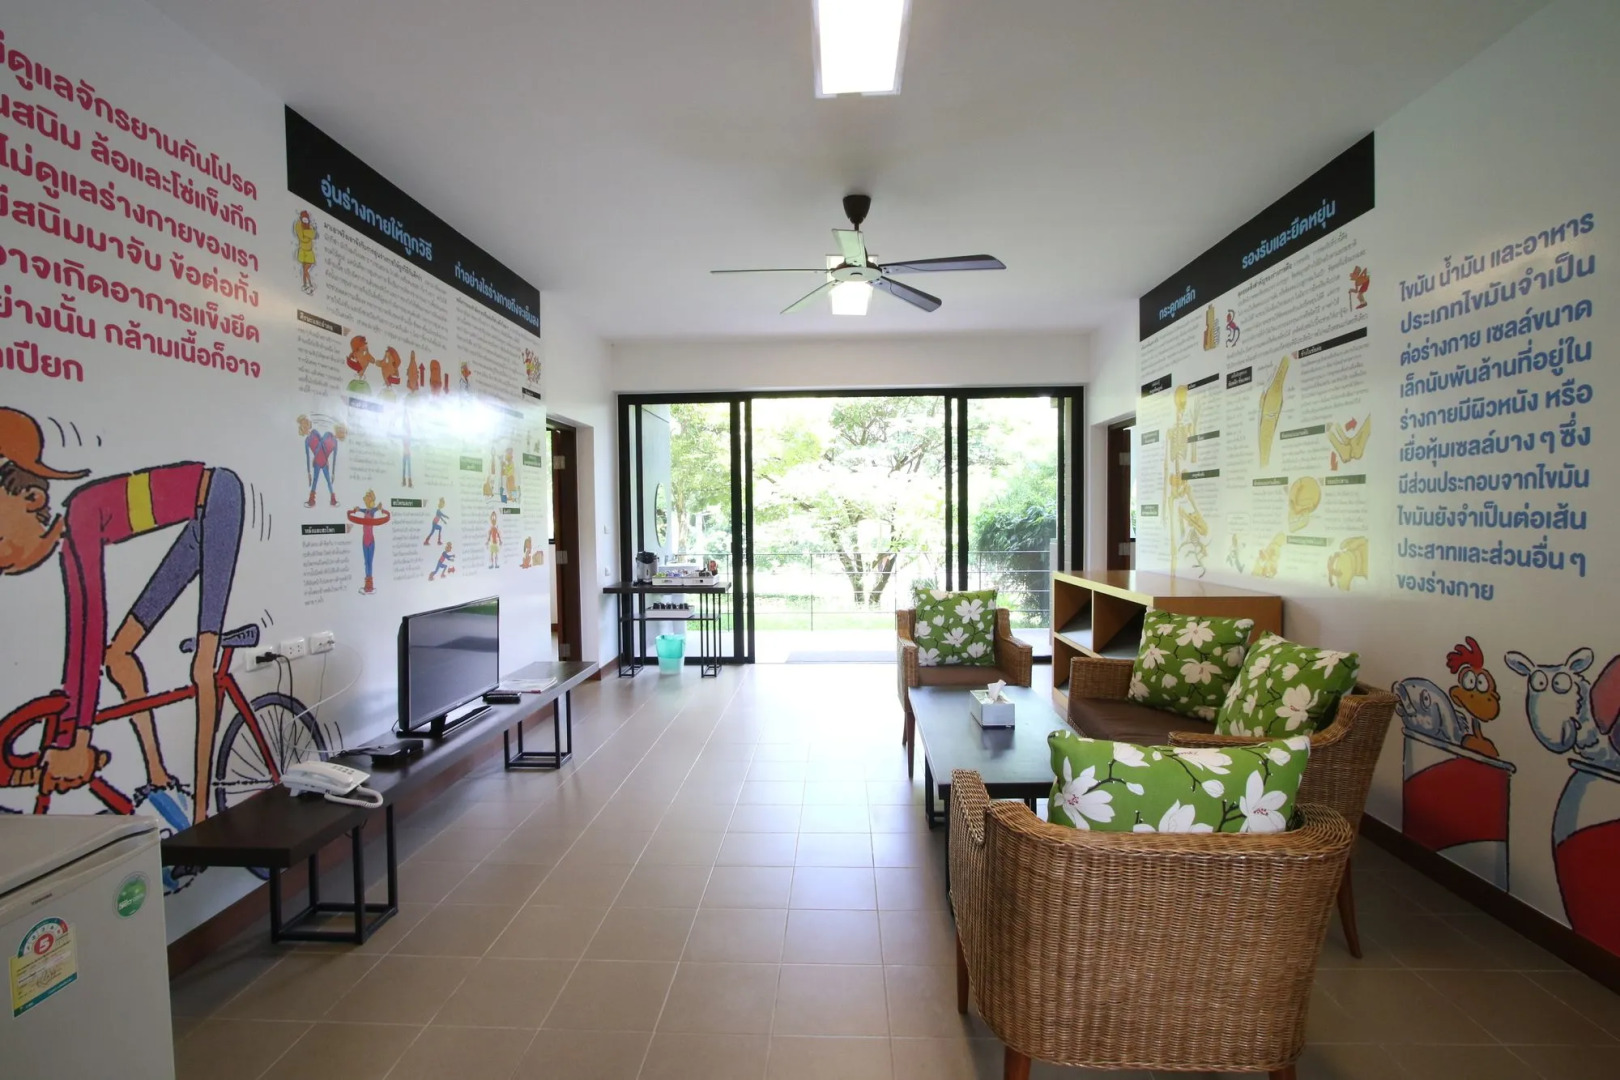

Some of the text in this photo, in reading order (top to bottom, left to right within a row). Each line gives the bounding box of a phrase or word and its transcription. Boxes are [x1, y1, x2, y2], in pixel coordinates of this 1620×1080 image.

[320, 174, 434, 262] อุ่นร่างกายให้ถูกวิธี
[1241, 198, 1336, 270] รองรับและยืดหยุ่น
[1399, 212, 1596, 302] ไขมัน น้ำมัน และอาหาร
[1159, 284, 1196, 321] กระดูกเหล็ก
[1400, 252, 1596, 334] ประเภทไขมันจำเป็น
[104, 320, 262, 378] กล้ามเนื้อก็อาจ
[1400, 298, 1594, 367] ต่อร่างกาย เซลล์ขนาด
[0, 340, 85, 383] เปียก
[1400, 336, 1593, 399] เล็กนับพันล้านที่อยู่ใน
[1400, 388, 1539, 431] ร่างกายมีผิวหนัง
[1545, 377, 1594, 410] หรือ
[1399, 411, 1592, 468] เยื่อหุ้มเซลล์บาง ๆ ซึ่ง
[1398, 462, 1590, 495] มีส่วนประกอบจากไขมัน
[1397, 500, 1588, 531] ไขมันยังจำเป็นต่อเส้น
[1397, 534, 1587, 578] ประสาทและส่วนอื่น ๆ
[1396, 570, 1495, 602] ของร่างกาย
[39, 936, 51, 952] 5
